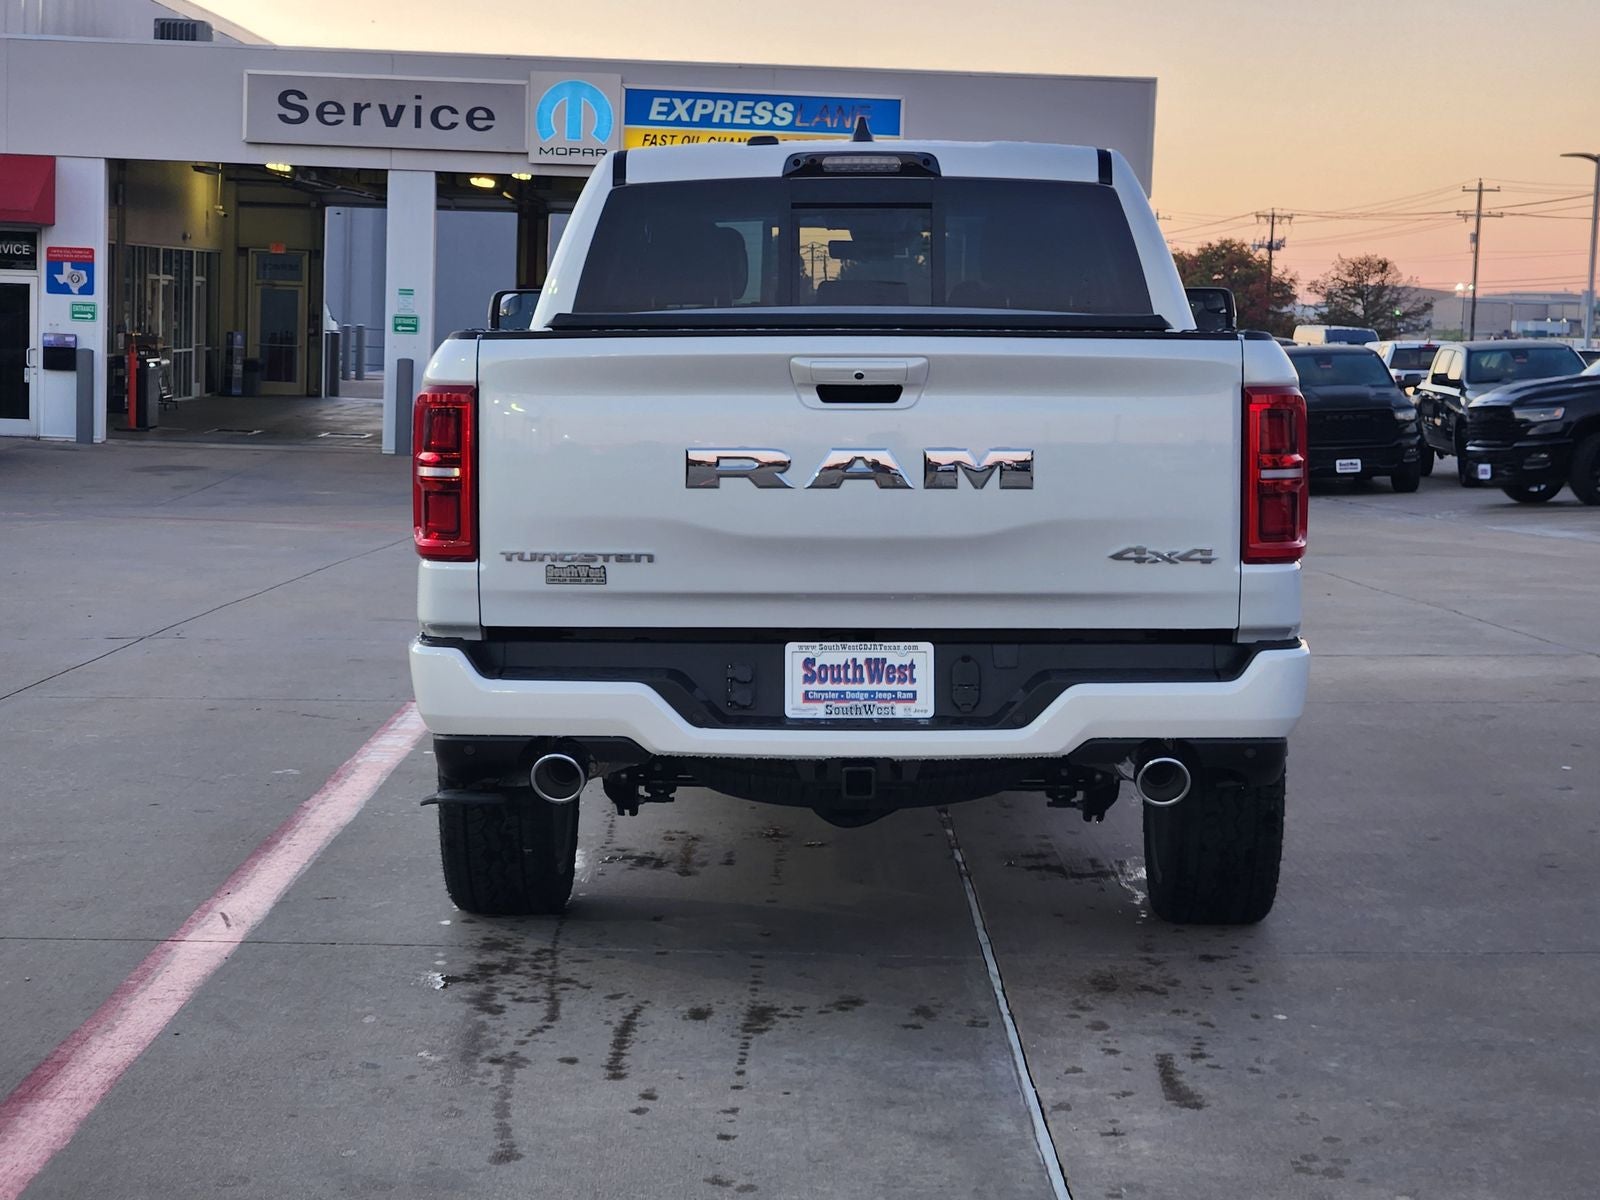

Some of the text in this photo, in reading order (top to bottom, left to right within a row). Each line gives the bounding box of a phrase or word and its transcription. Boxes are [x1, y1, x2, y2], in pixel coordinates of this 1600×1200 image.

[277, 89, 496, 132] Service
[648, 97, 795, 127] EXPRESS
[641, 133, 677, 147] FAST
[538, 147, 608, 157] MOPAR
[0, 244, 31, 255] VICE
[685, 447, 1034, 490] RAM
[802, 657, 917, 685] SouthWest
[808, 691, 839, 700] Chrysler
[846, 691, 869, 700] Dodge
[875, 692, 892, 700] Jeep
[825, 704, 896, 715] SouthWest
